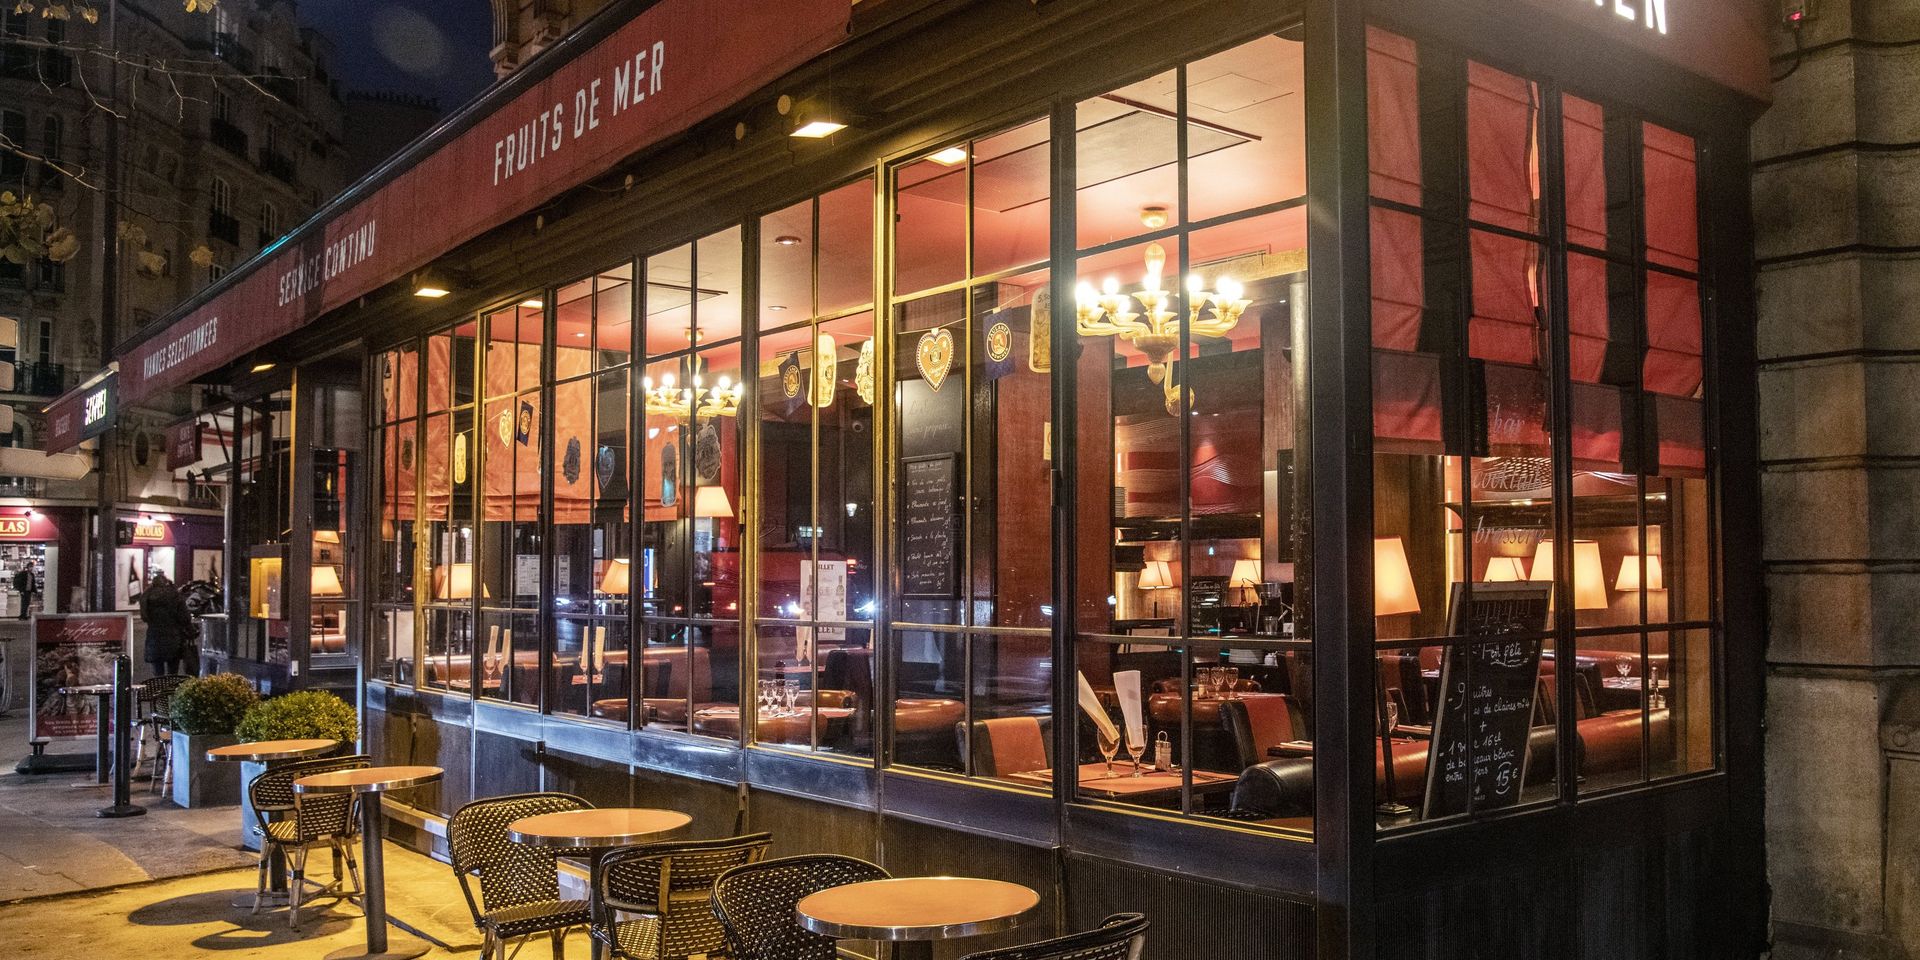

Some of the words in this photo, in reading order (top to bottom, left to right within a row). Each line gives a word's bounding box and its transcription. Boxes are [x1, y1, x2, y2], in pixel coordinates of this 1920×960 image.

[494, 102, 563, 186] FRUITS
[574, 78, 601, 139] DE
[613, 40, 664, 116] MER
[279, 254, 320, 307] SERVICE
[324, 219, 376, 281] CONTINU
[143, 346, 167, 381] VIANDES
[166, 316, 218, 368] SELECTIONNEES
[1494, 403, 1525, 436] bar
[1475, 515, 1546, 545] brasserie
